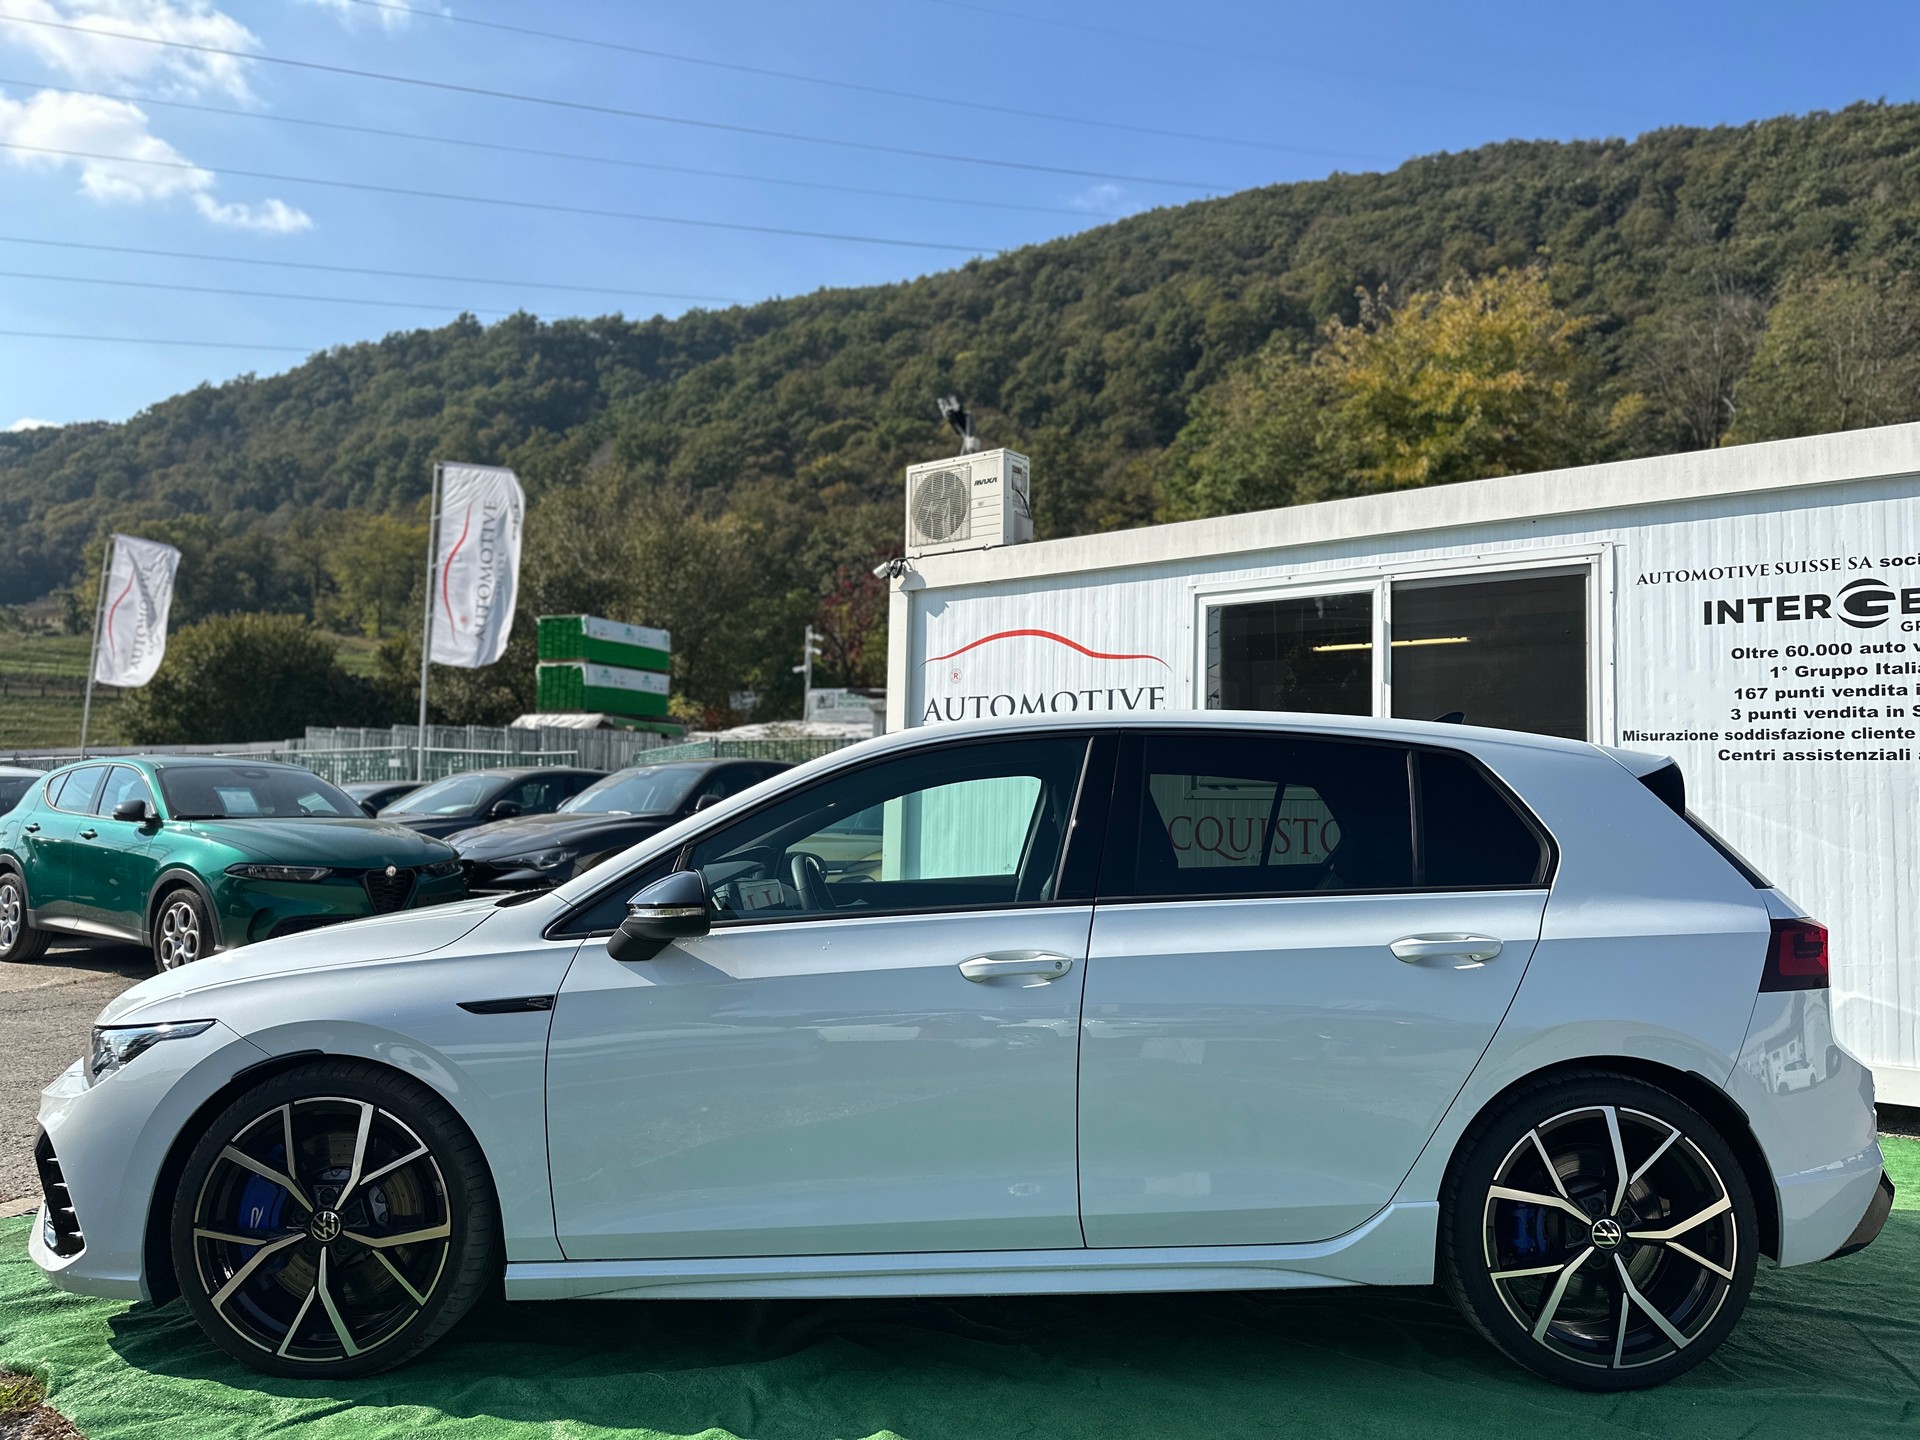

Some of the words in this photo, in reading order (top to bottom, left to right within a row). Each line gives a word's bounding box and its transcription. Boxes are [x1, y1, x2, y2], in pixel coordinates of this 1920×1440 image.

[973, 476, 998, 486] MAXA
[475, 499, 498, 641] AUTOMOTIVE
[1636, 563, 1770, 586] AUTOMOTIVE
[1774, 557, 1841, 575] SUISSE
[1847, 556, 1873, 570] SA
[1731, 646, 1779, 660] Oltre
[1785, 642, 1853, 658] 60.000
[1859, 641, 1906, 655] auto
[1795, 664, 1868, 680] Gruppo
[1875, 662, 1920, 676] Itali
[1734, 687, 1768, 700] 167
[1775, 686, 1825, 702] punti
[1832, 683, 1909, 698] vendita
[1730, 708, 1742, 721] 3
[1748, 707, 1797, 723] punti
[1803, 705, 1879, 720] vendita
[1886, 705, 1905, 718] in
[1622, 729, 1719, 742] Misurazione
[1724, 728, 1845, 741] soddisfazione
[1850, 726, 1916, 740] cliente
[1718, 749, 1776, 761] Centri
[1782, 748, 1911, 761] assistenziali
